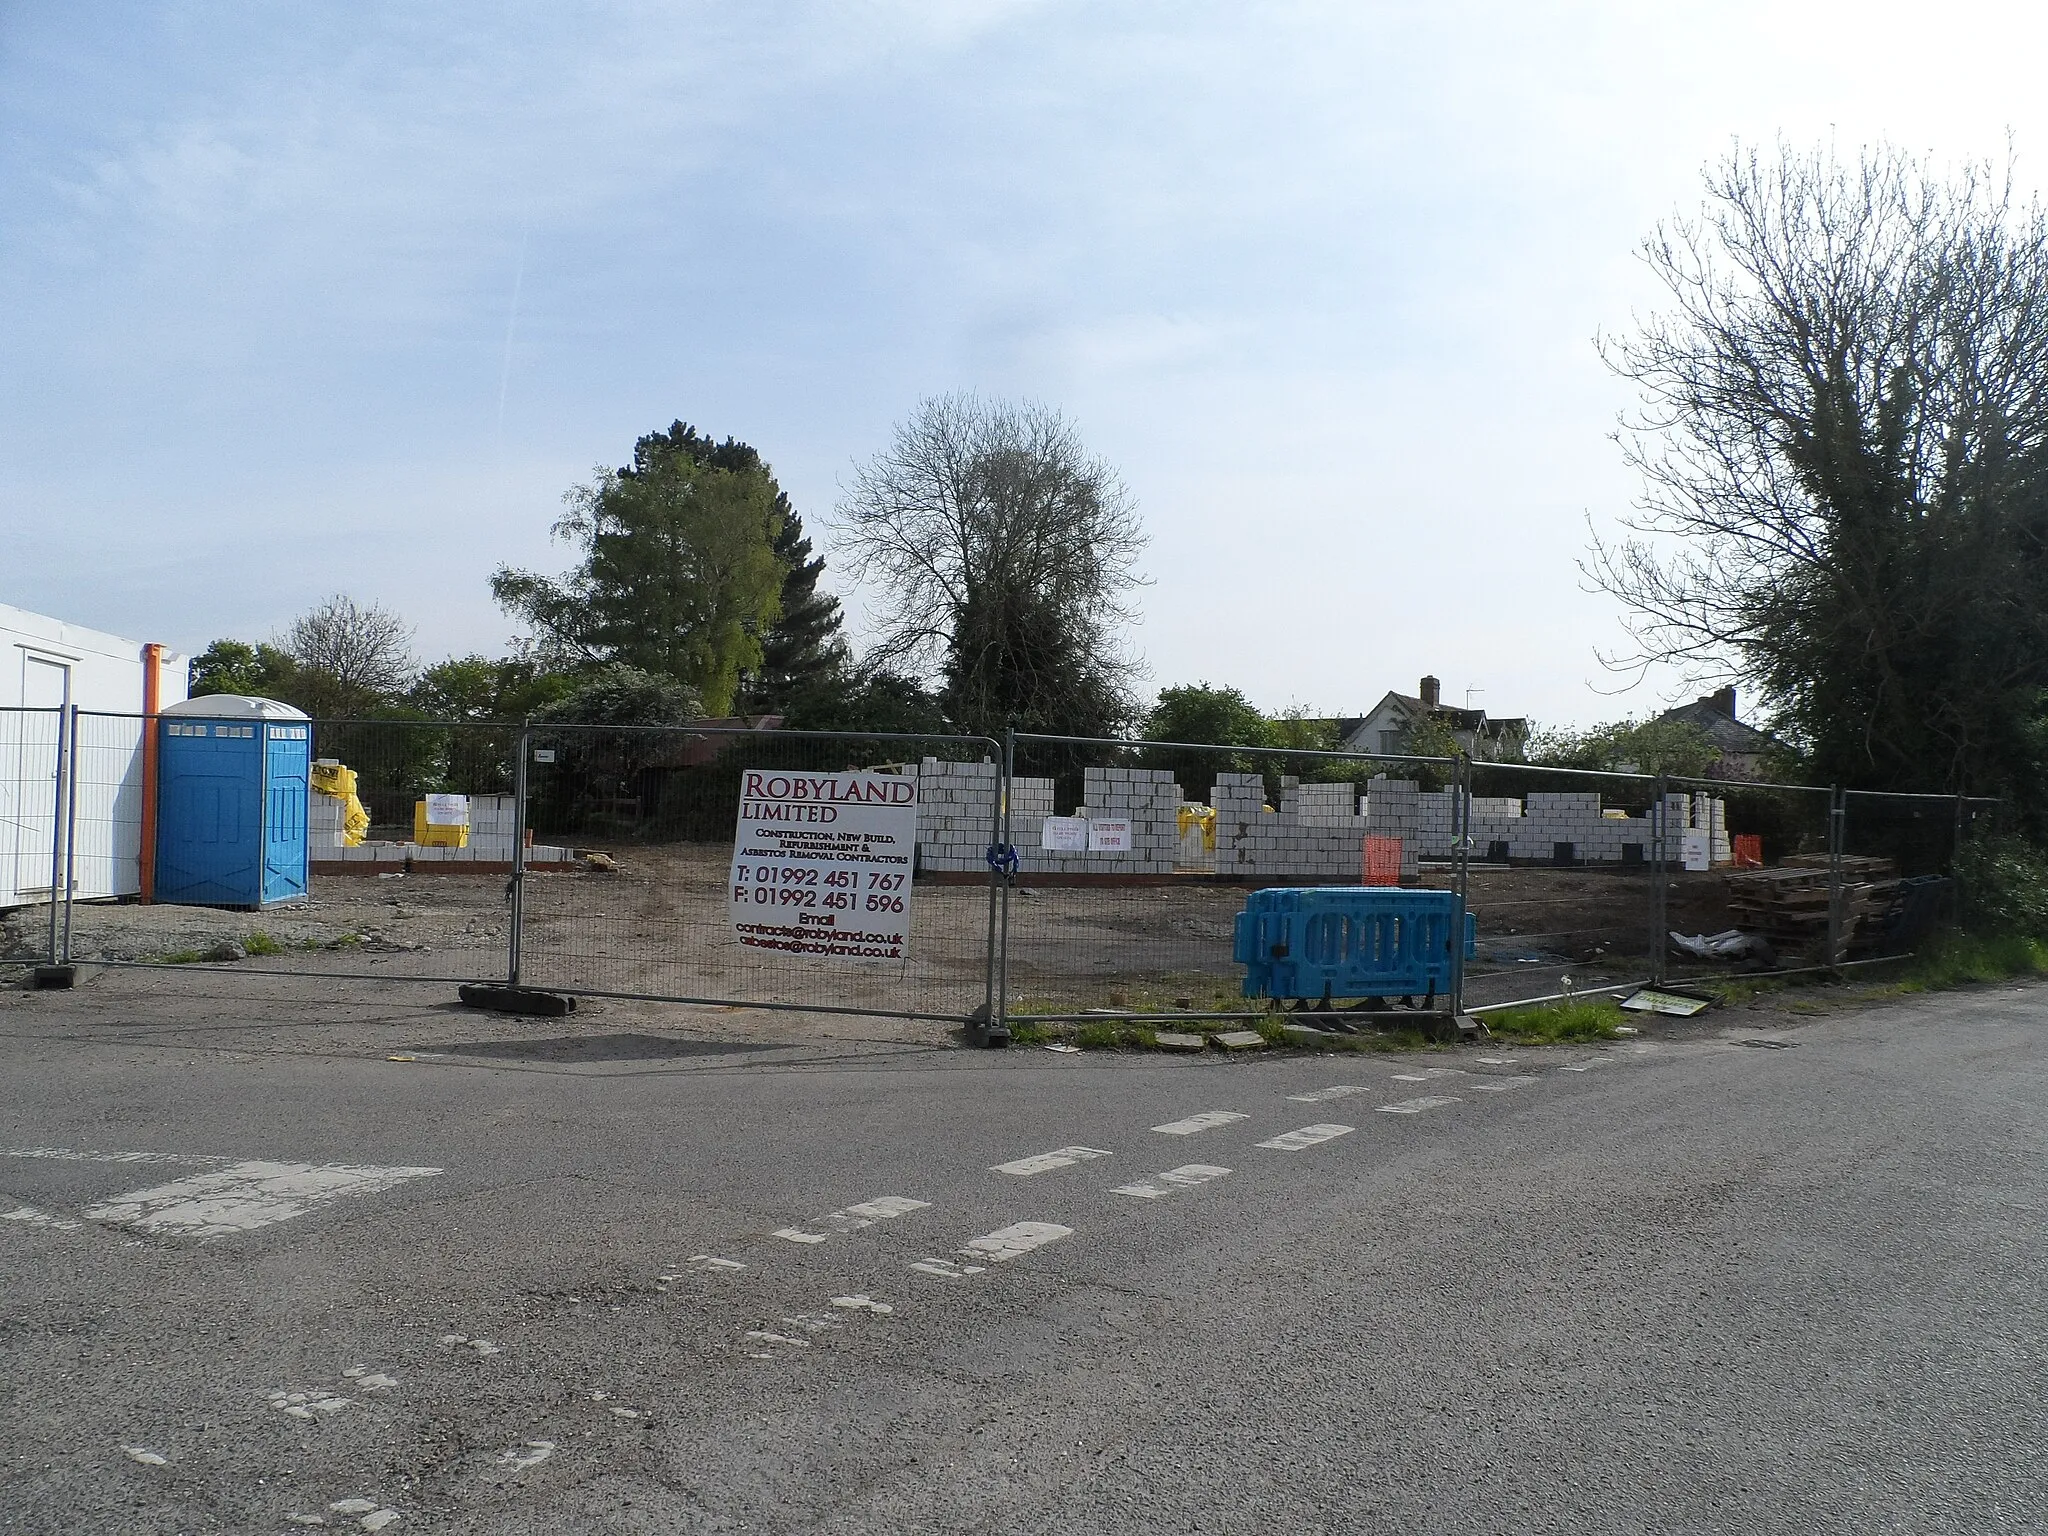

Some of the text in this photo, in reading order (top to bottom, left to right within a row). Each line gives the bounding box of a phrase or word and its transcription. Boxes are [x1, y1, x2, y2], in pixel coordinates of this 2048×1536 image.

[744, 774, 915, 803] ROBYLAND
[742, 803, 838, 823] LIMITED
[780, 840, 871, 852] REFURBISHMENT &
[837, 833, 861, 841] NEW
[864, 834, 895, 844] BUILD,
[740, 848, 908, 864] ASBESTOS REMOVAL CONTRACTORS
[737, 865, 905, 891] T: 01992 451 767
[734, 886, 904, 913] F: 01992 451 596
[799, 913, 834, 926] Email
[736, 923, 903, 945] contracts@robyland.co.uk
